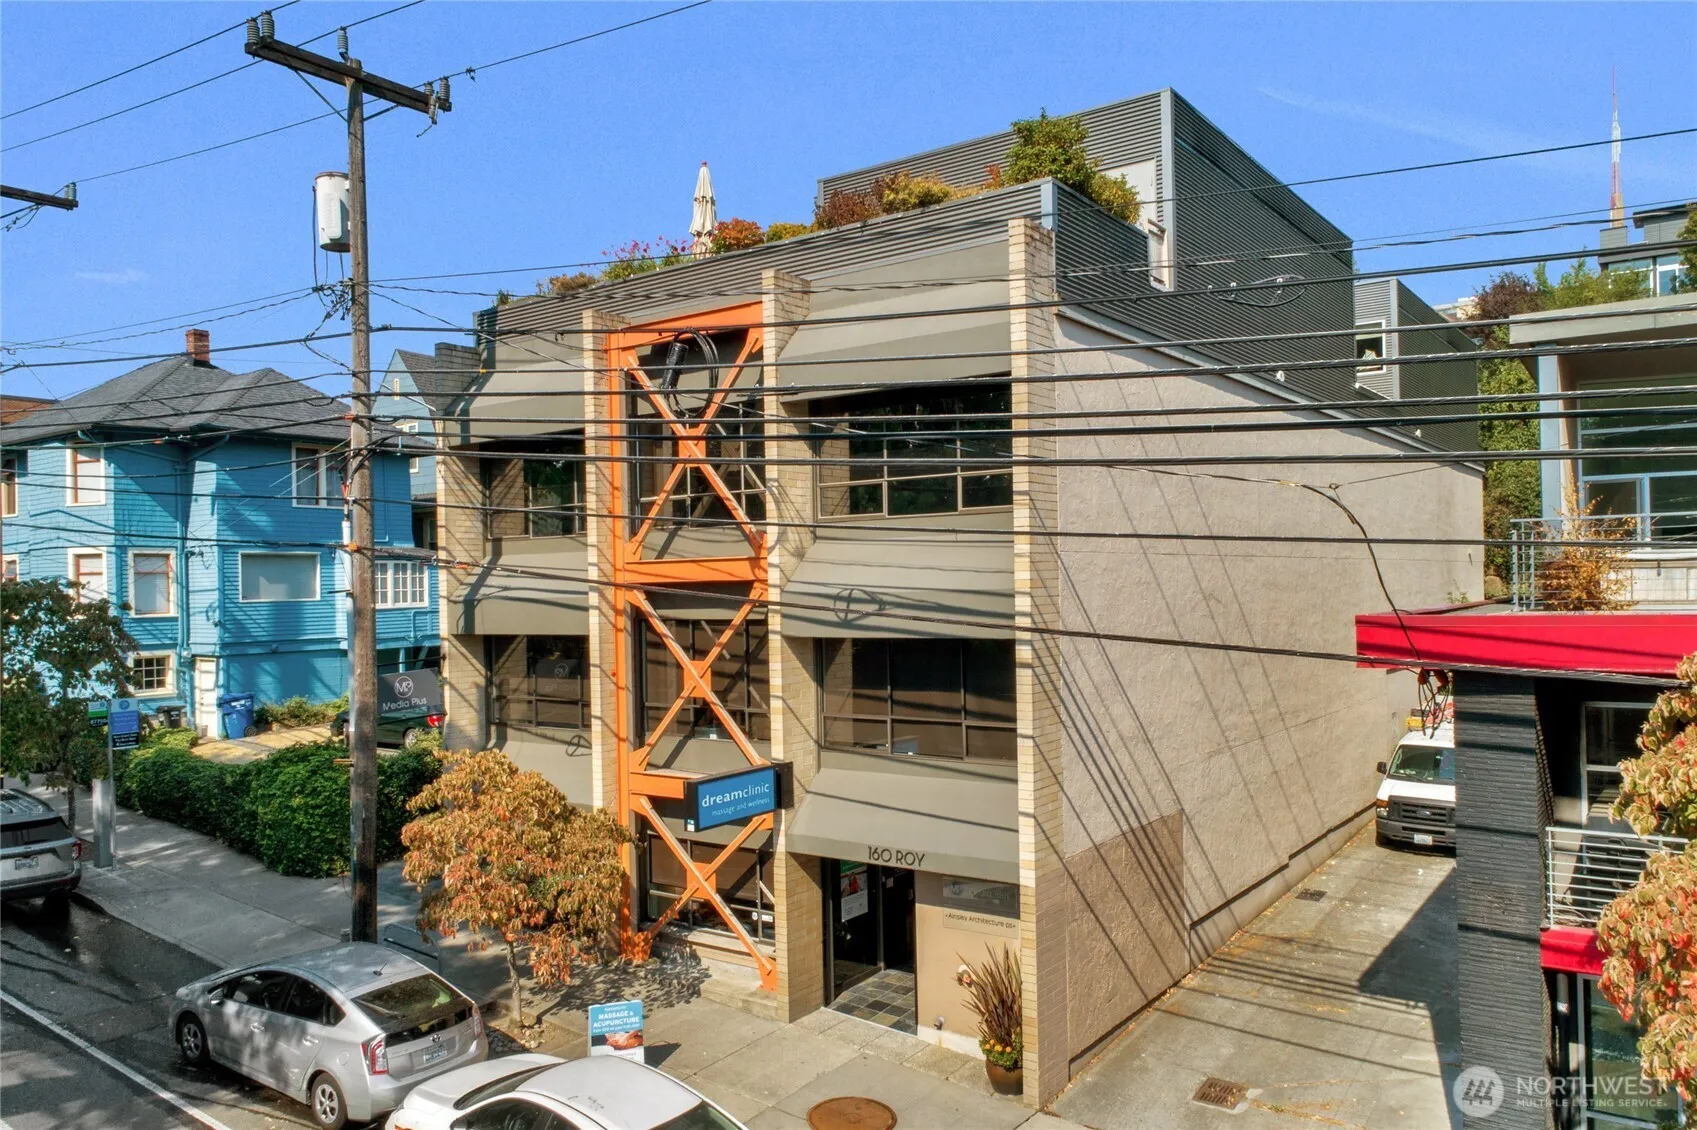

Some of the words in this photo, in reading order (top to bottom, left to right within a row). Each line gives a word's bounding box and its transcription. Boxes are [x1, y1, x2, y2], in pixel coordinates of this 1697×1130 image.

[382, 700, 410, 710] Media
[411, 697, 427, 706] Plus
[702, 782, 769, 807] dreamclinic
[712, 807, 735, 815] massage
[736, 802, 746, 810] and
[868, 845, 893, 863] 160
[895, 849, 926, 868] ROY
[968, 915, 1005, 928] Architecture
[593, 1016, 639, 1028] ACUPUNCTURE
[598, 1011, 628, 1020] MASSAGE
